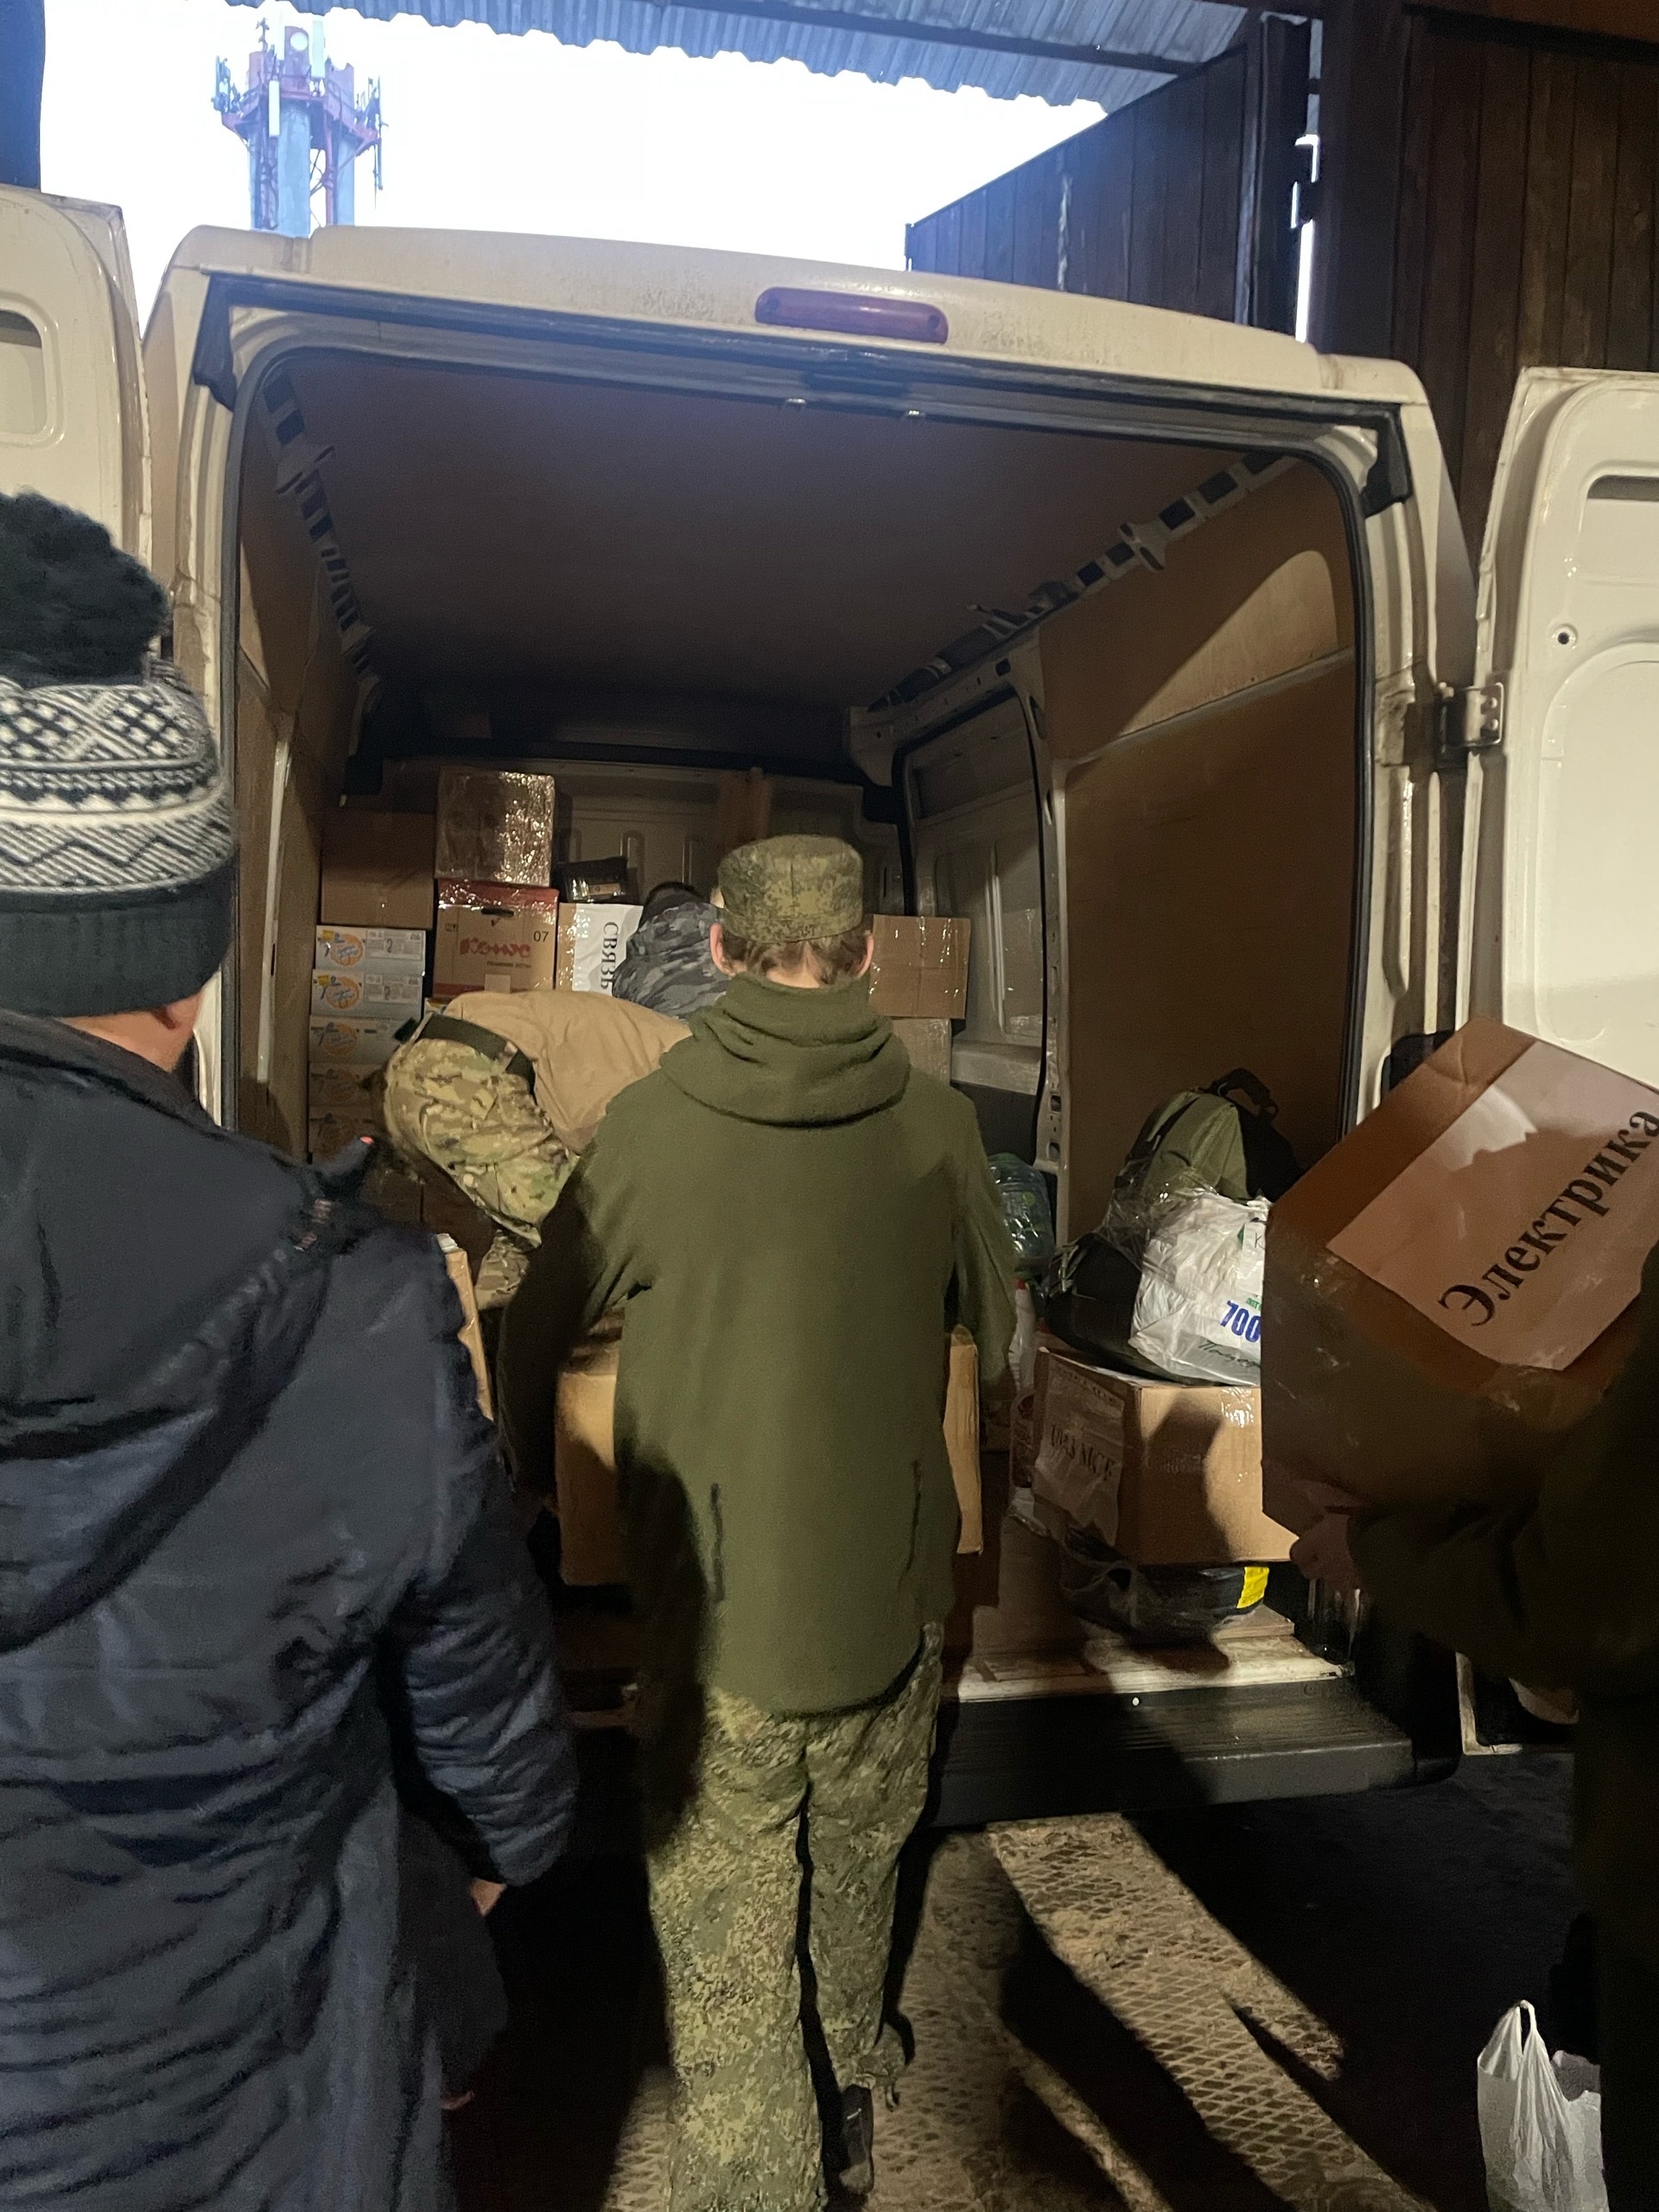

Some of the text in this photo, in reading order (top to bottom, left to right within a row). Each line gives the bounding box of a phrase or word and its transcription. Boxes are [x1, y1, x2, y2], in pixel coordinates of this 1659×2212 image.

[533, 930, 550, 943] 07
[1437, 1110, 1659, 1326] Электрика
[1219, 1300, 1262, 1343] 700
